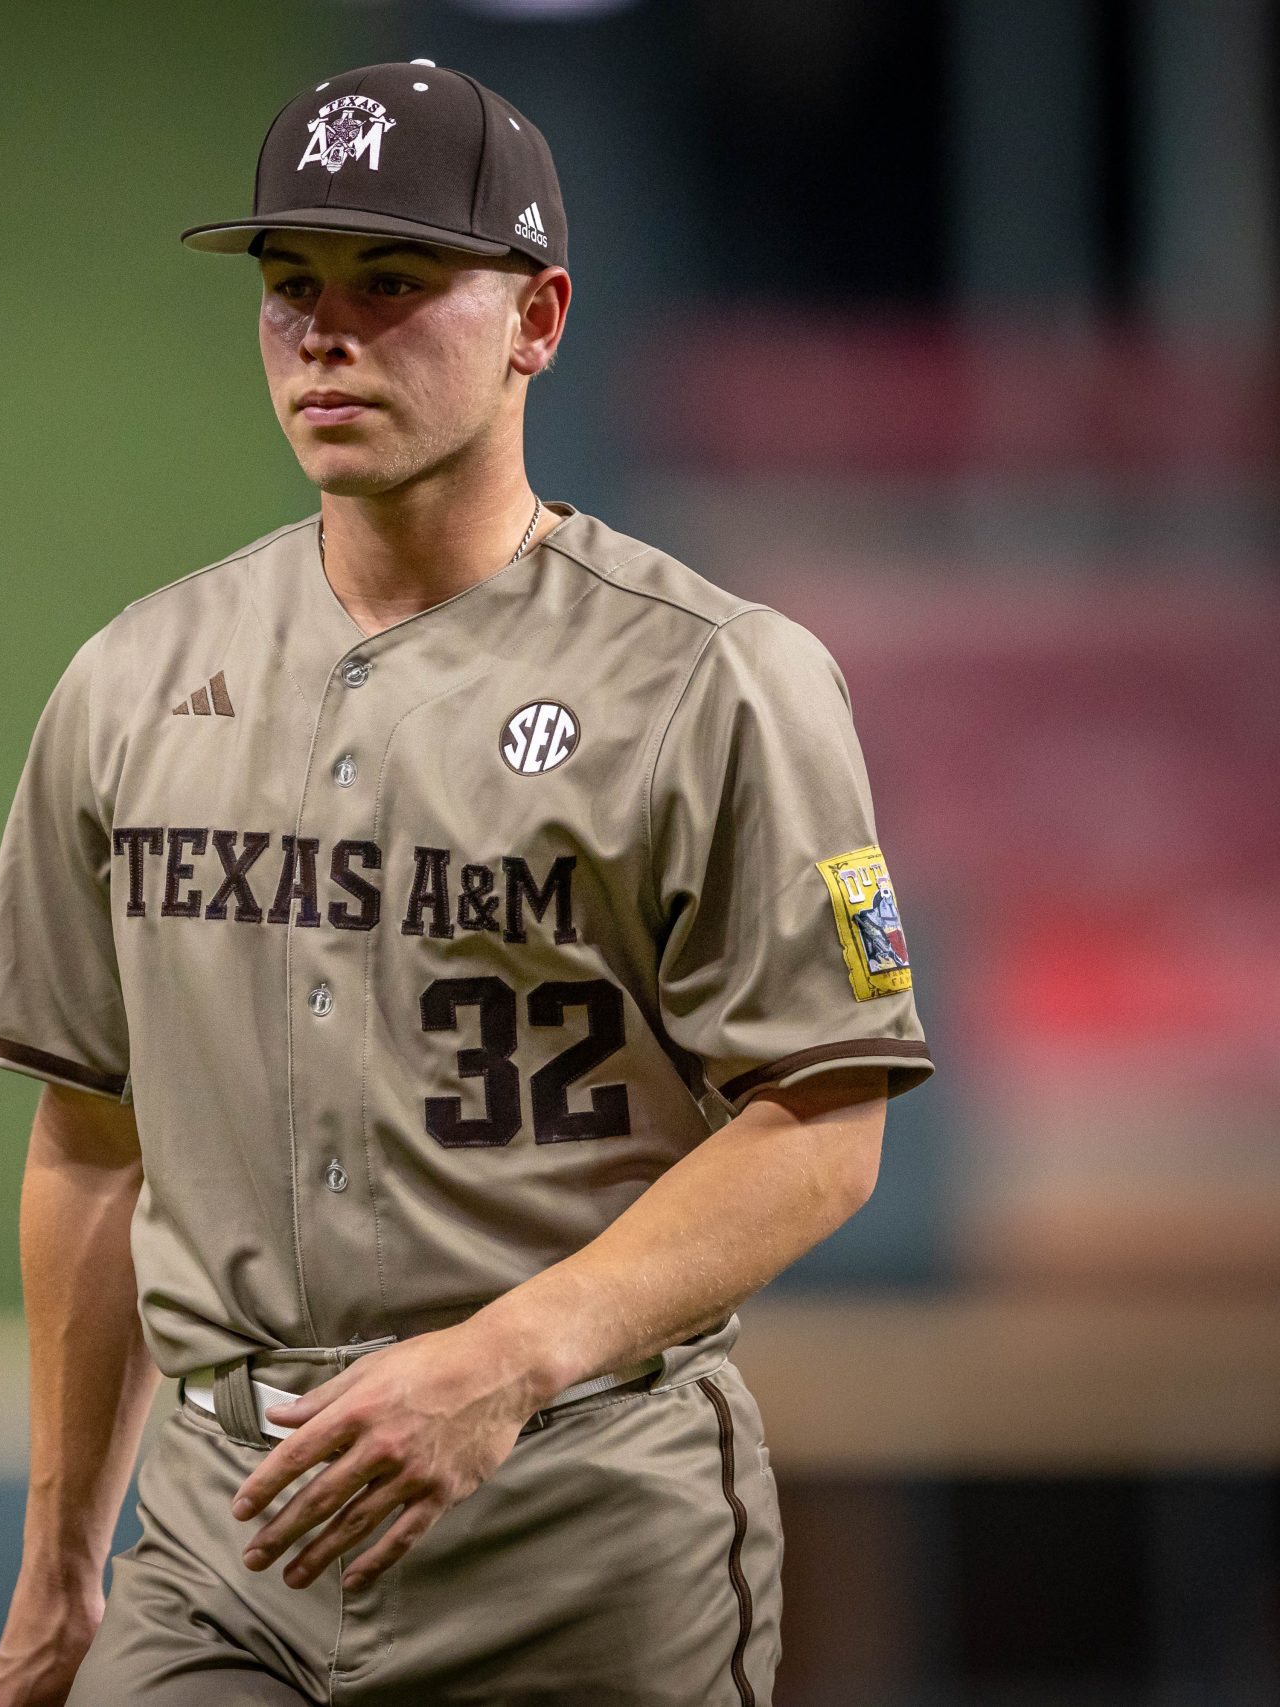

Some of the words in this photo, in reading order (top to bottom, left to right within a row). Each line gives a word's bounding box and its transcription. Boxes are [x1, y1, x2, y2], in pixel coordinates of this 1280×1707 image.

[325, 96, 380, 113] TEXAS
[514, 223, 548, 248] adidas
[504, 703, 576, 773] SEC
[113, 827, 381, 931] TEXAS
[401, 845, 577, 945] A&M
[420, 976, 631, 1148] 32
